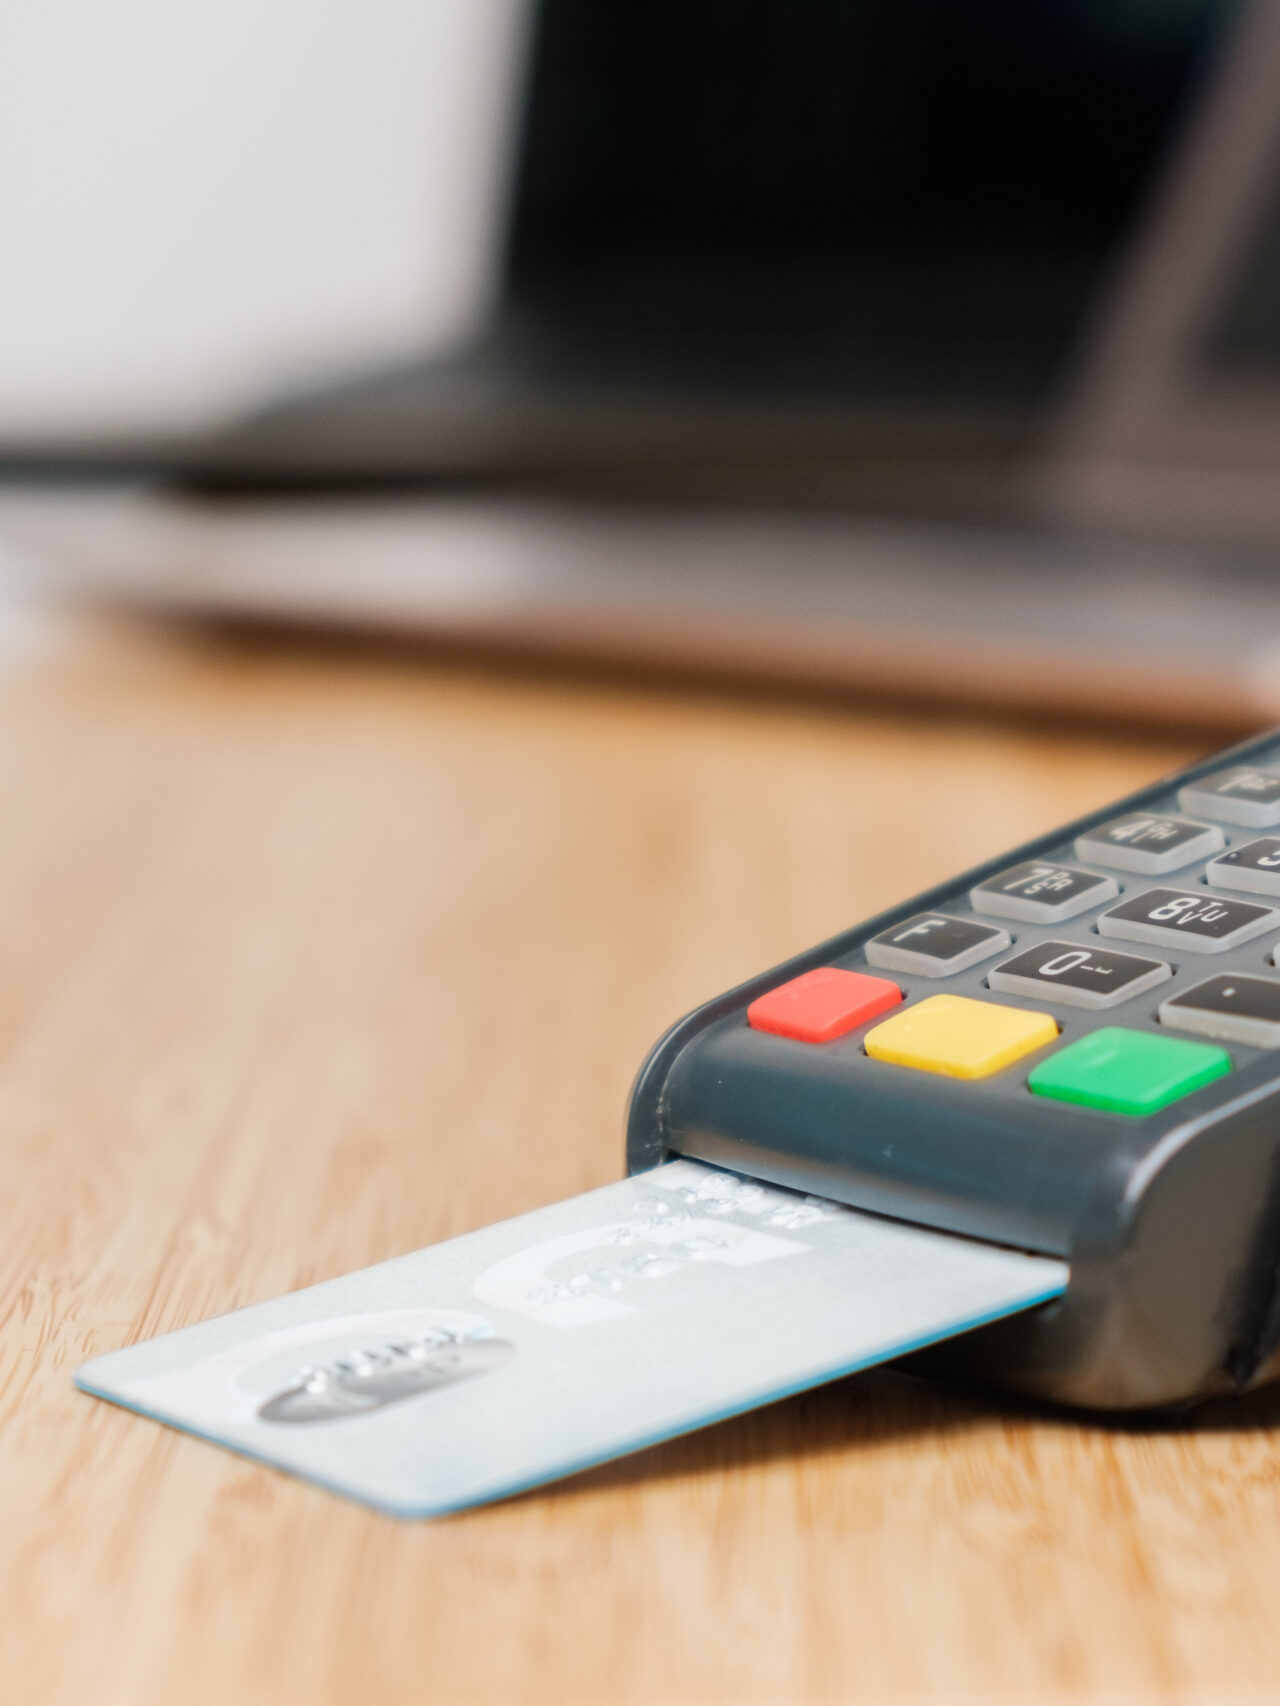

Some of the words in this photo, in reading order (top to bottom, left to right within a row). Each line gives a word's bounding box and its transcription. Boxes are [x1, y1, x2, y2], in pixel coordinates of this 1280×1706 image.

[1109, 820, 1156, 841] 4
[1003, 868, 1056, 890] 7
[1148, 897, 1201, 921] 8
[893, 920, 948, 942] F
[1039, 951, 1093, 976] 0
